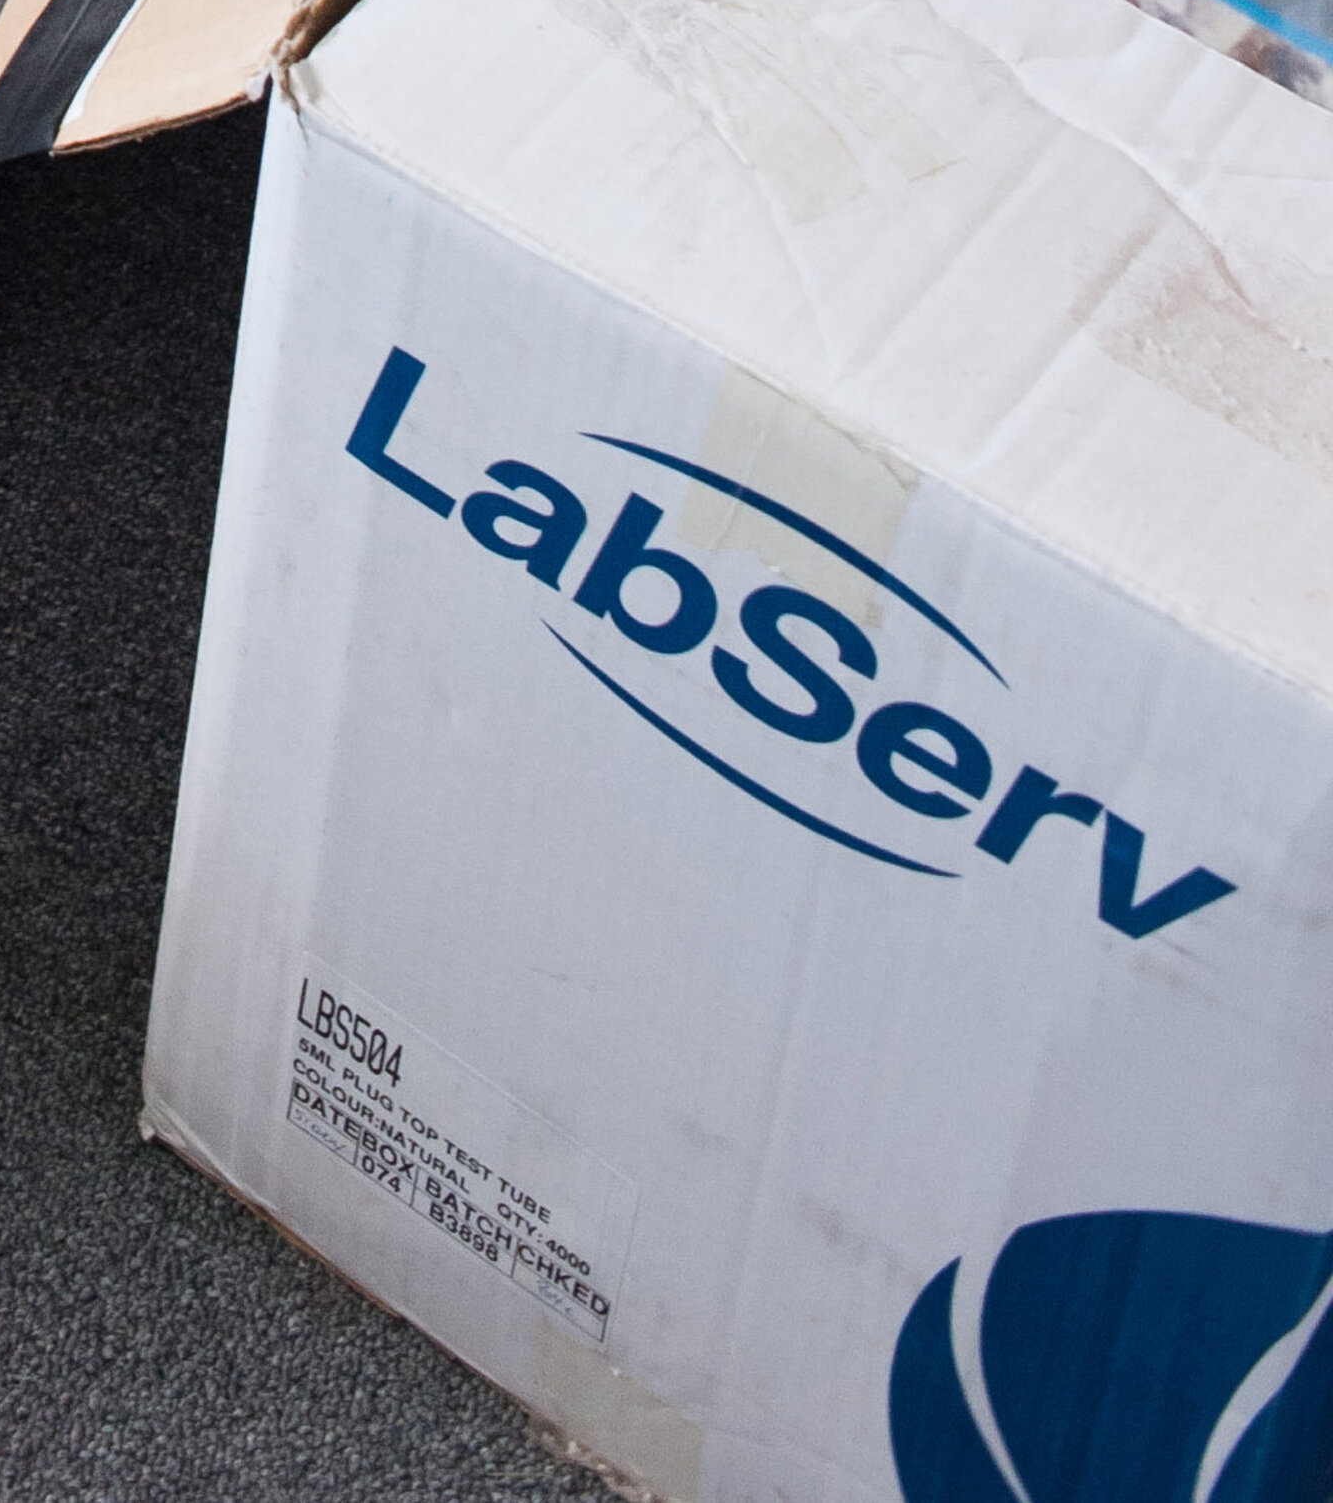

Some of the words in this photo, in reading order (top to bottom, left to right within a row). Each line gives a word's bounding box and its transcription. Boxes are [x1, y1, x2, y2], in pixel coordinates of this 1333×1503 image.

[345, 346, 1239, 941] LabServ
[297, 978, 403, 1086] LBS504
[293, 1083, 360, 1142] DATE
[359, 1131, 416, 1180] BOX
[424, 1177, 513, 1251] BATCH
[519, 1244, 610, 1317] CHKED
[299, 1038, 334, 1071] 5ML
[343, 1068, 393, 1112] PLUG
[400, 1107, 438, 1139] TOP
[445, 1139, 492, 1180] TEST
[499, 1177, 549, 1223] TUBE
[362, 1155, 400, 1192] 074
[430, 1202, 508, 1261] B3898
